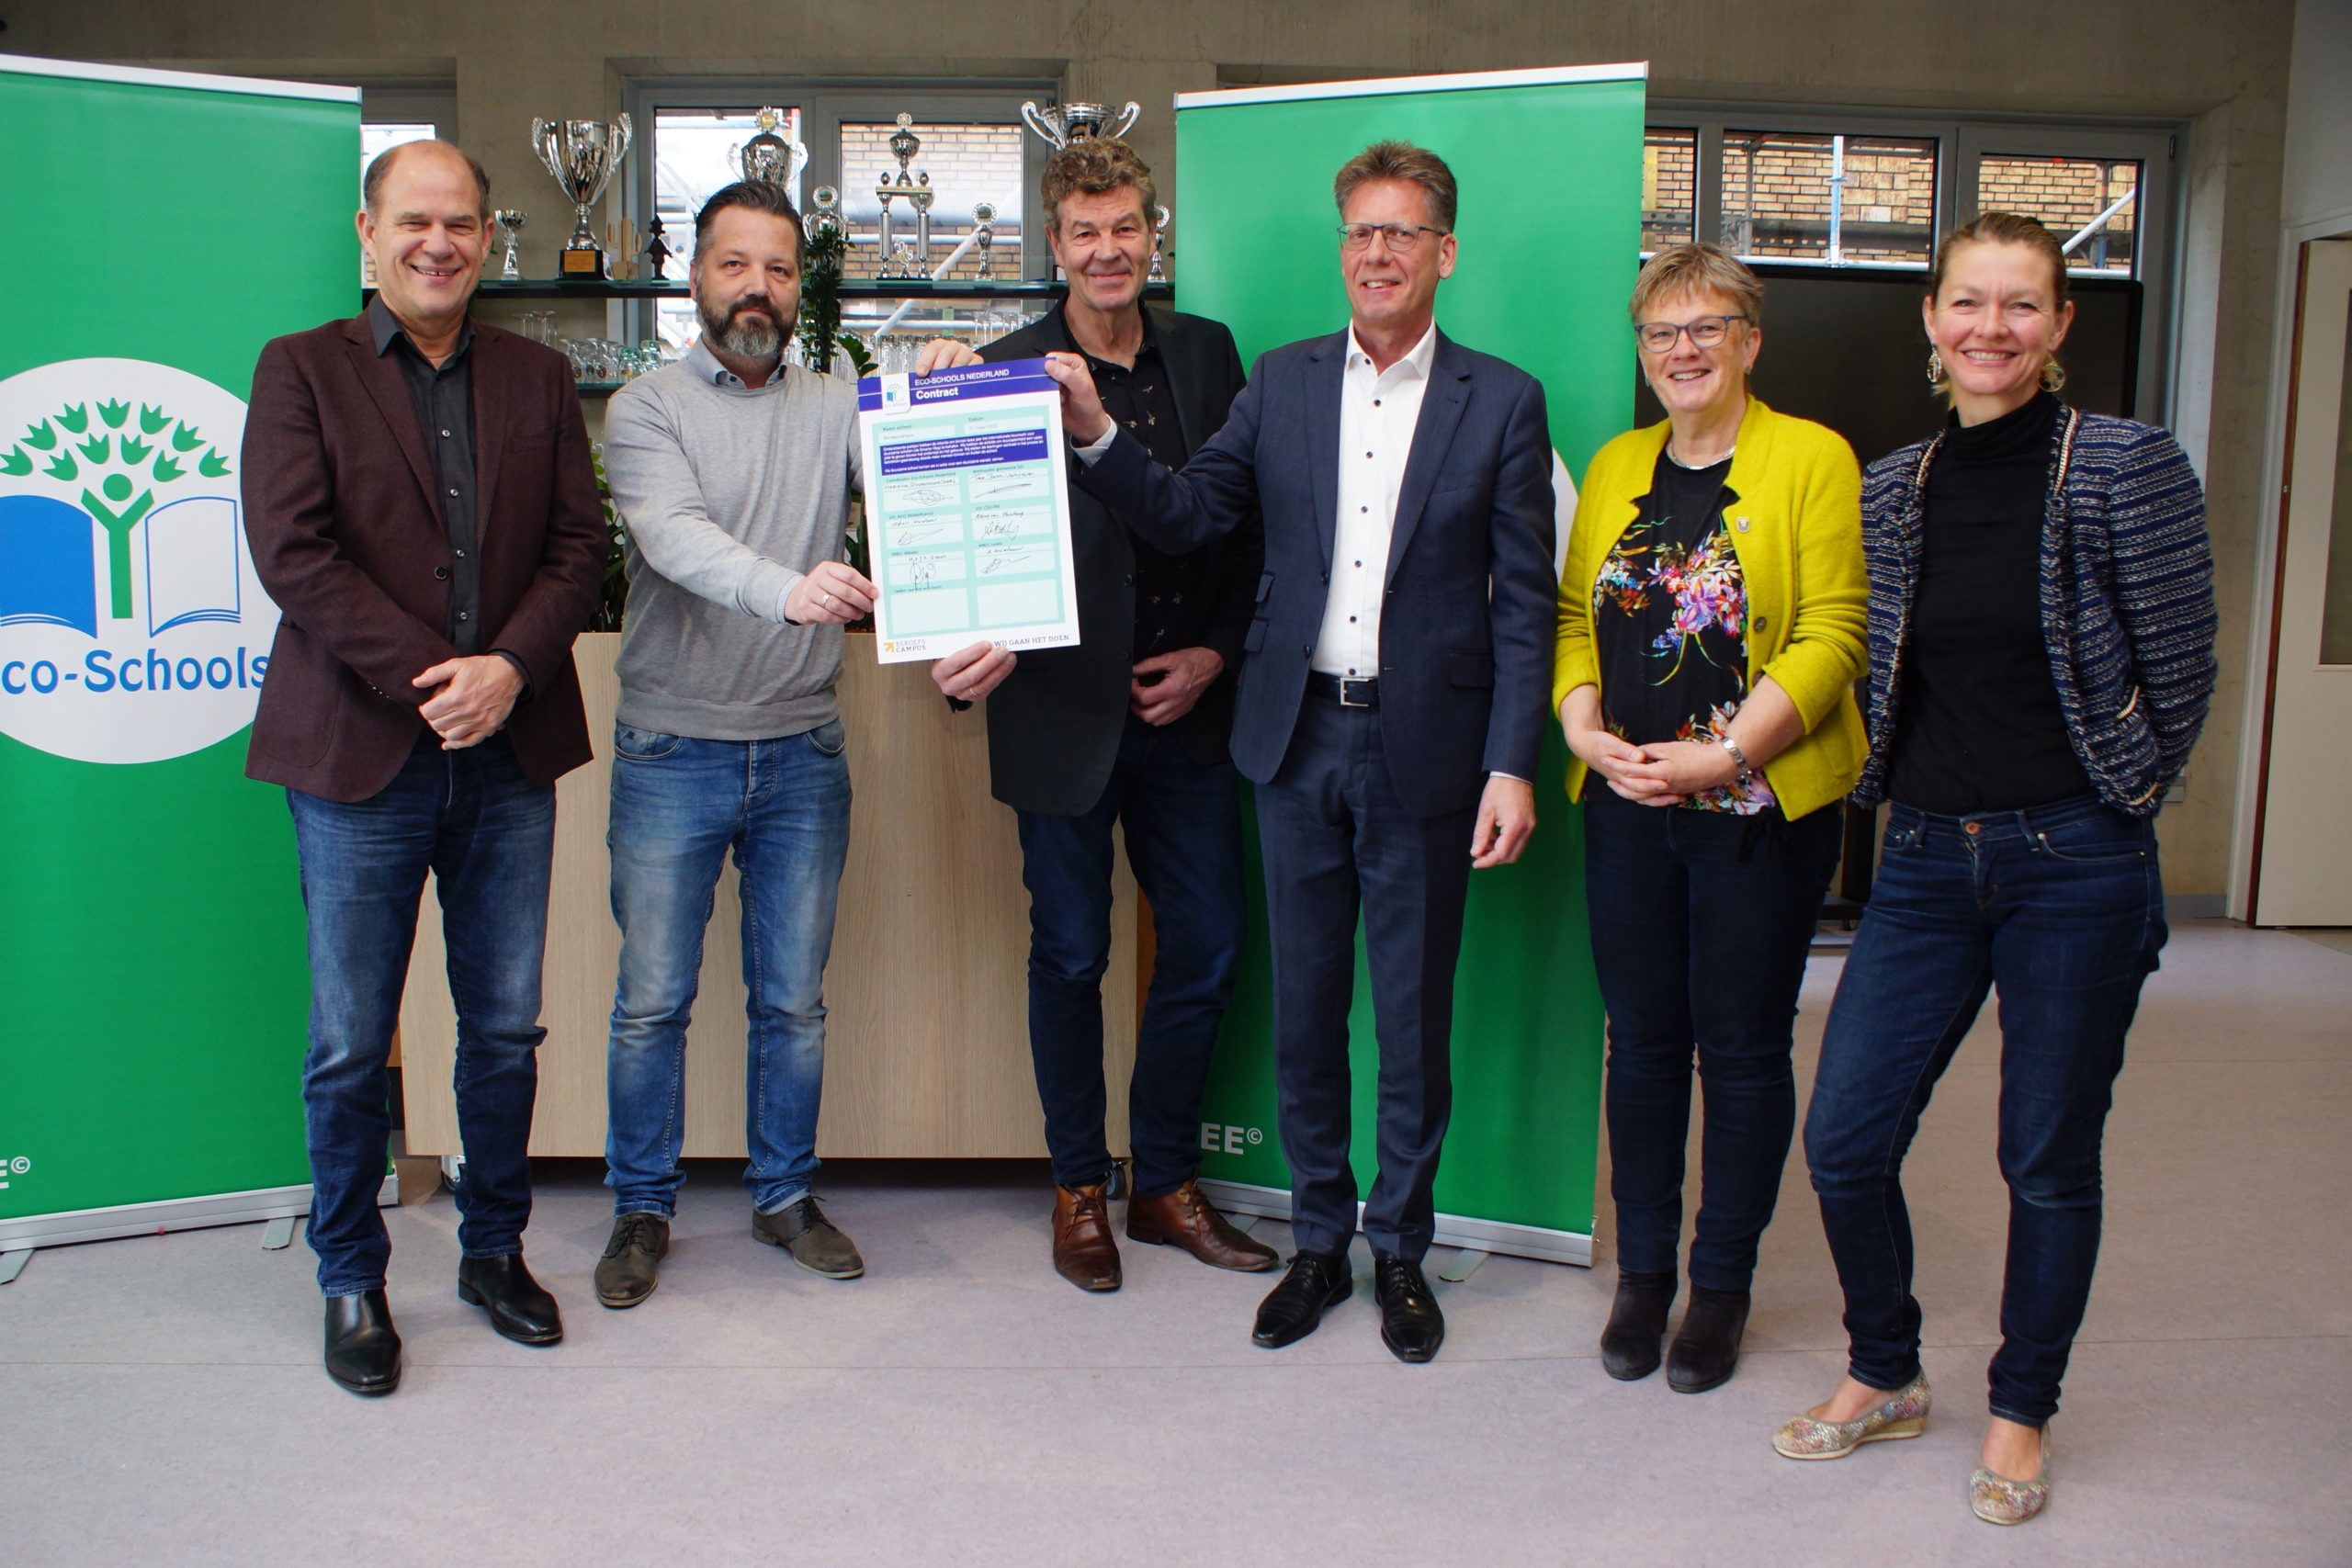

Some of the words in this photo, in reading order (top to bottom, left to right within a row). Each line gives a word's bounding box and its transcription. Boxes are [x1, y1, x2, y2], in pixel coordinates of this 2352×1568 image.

[914, 374, 965, 386] ECO-SCHOOLS
[966, 368, 1009, 379] NEDERLAND
[915, 386, 958, 400] Contract
[896, 644, 926, 653] CAMPUS
[994, 639, 1007, 649] WIJ
[1009, 637, 1030, 647] GAAN
[1032, 636, 1046, 644] HET
